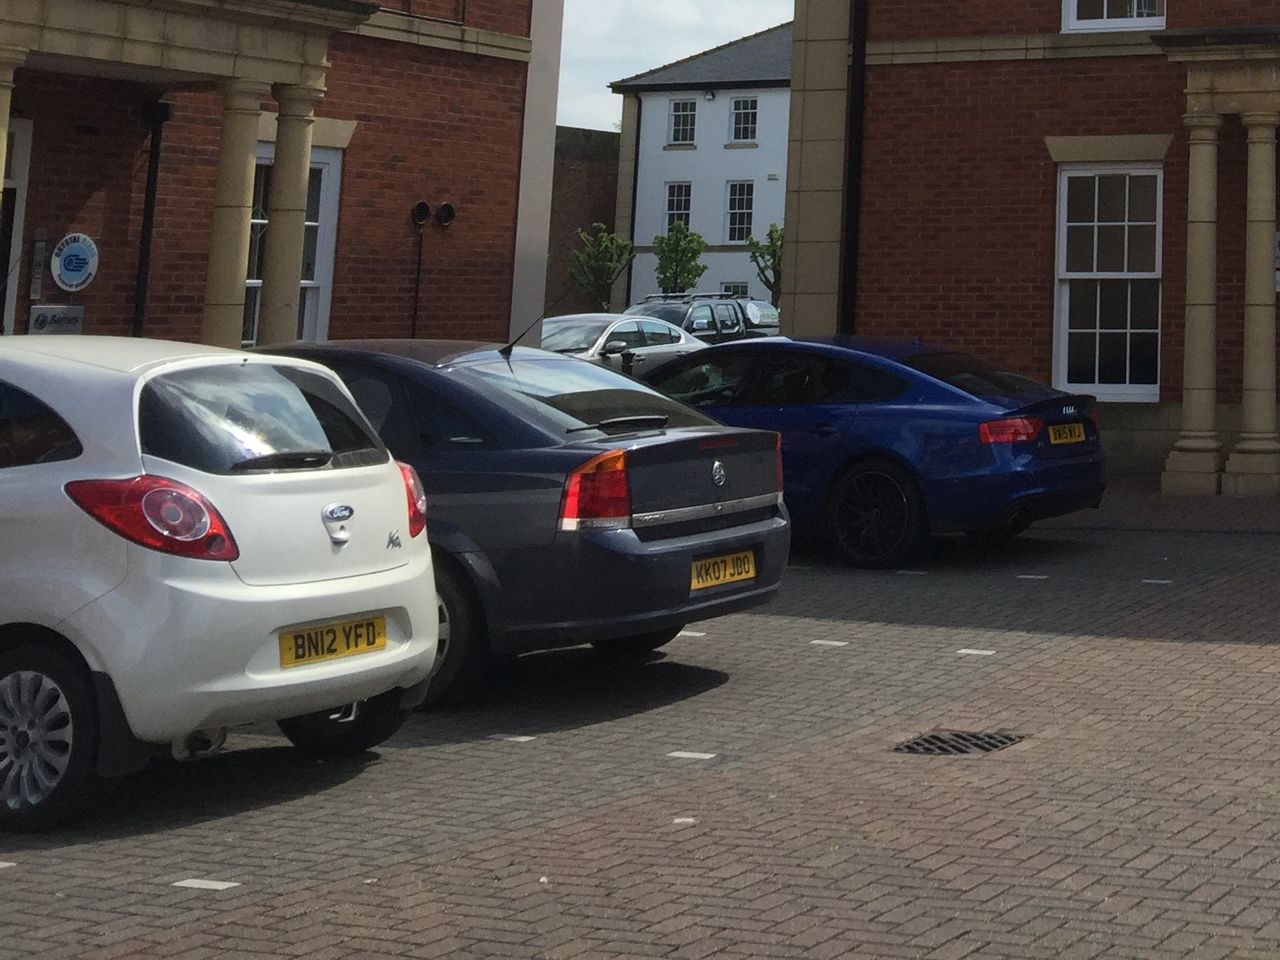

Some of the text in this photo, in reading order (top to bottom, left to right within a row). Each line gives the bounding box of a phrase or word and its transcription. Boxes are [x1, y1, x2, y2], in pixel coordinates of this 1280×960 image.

[333, 506, 350, 518] Ford
[385, 529, 402, 549] Ka
[695, 559, 727, 584] KK07
[294, 622, 377, 660] BN12 YFD
